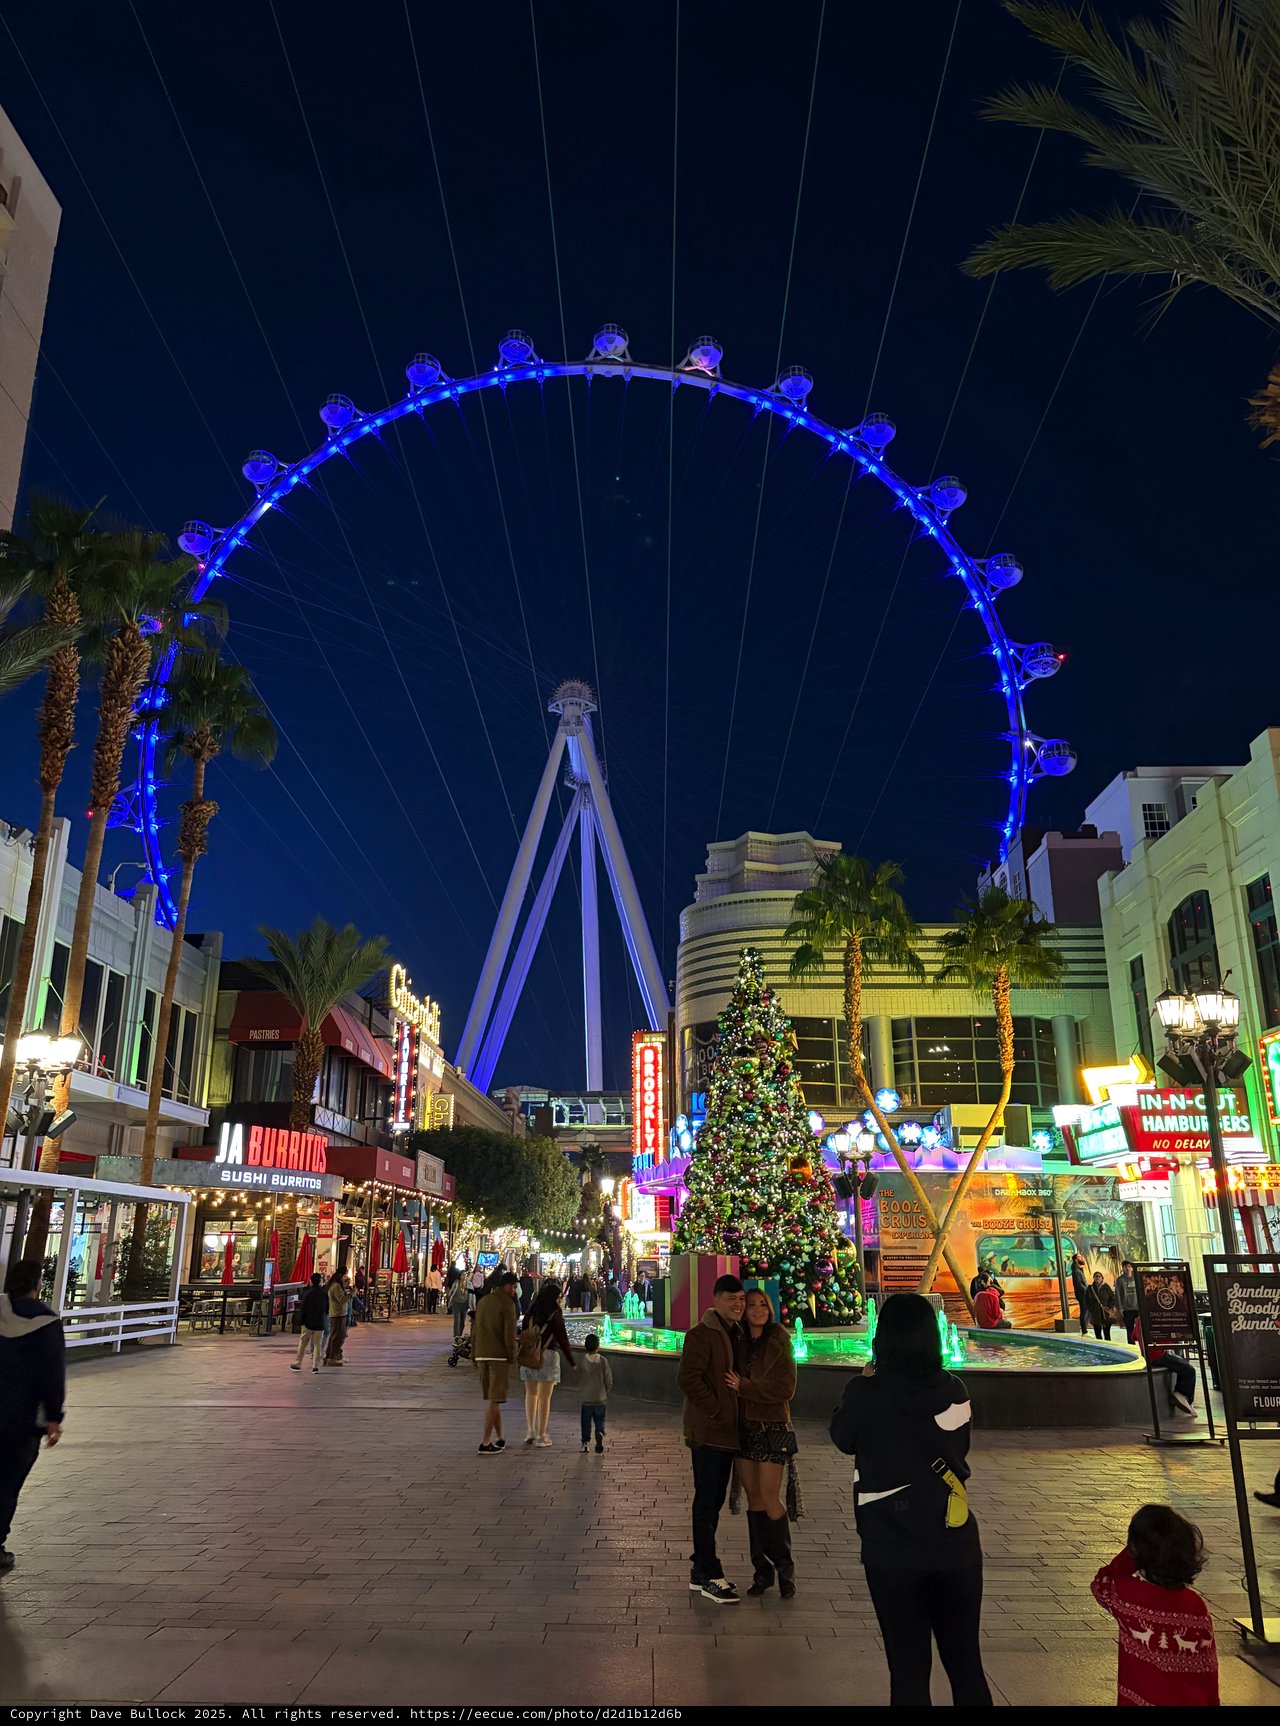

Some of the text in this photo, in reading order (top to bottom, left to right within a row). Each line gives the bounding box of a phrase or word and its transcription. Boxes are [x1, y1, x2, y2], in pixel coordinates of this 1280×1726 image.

[249, 1029, 280, 1040] PASTRIES
[398, 1025, 411, 1123] FAVORITE
[1142, 1115, 1251, 1132] HAMBURERS
[215, 1122, 329, 1174] JA BURRITOS
[1152, 1139, 1211, 1150] NO DELAY
[220, 1170, 322, 1190] SUSHI BURRITOS
[879, 1189, 894, 1197] THE
[879, 1199, 921, 1213] BOOZ
[880, 1214, 928, 1228] CRUIS
[982, 1219, 1015, 1229] BOOZE
[891, 1231, 934, 1240] EXPERIENC
[1228, 1299, 1280, 1319] Bloody
[1231, 1315, 1280, 1334] Sunda
